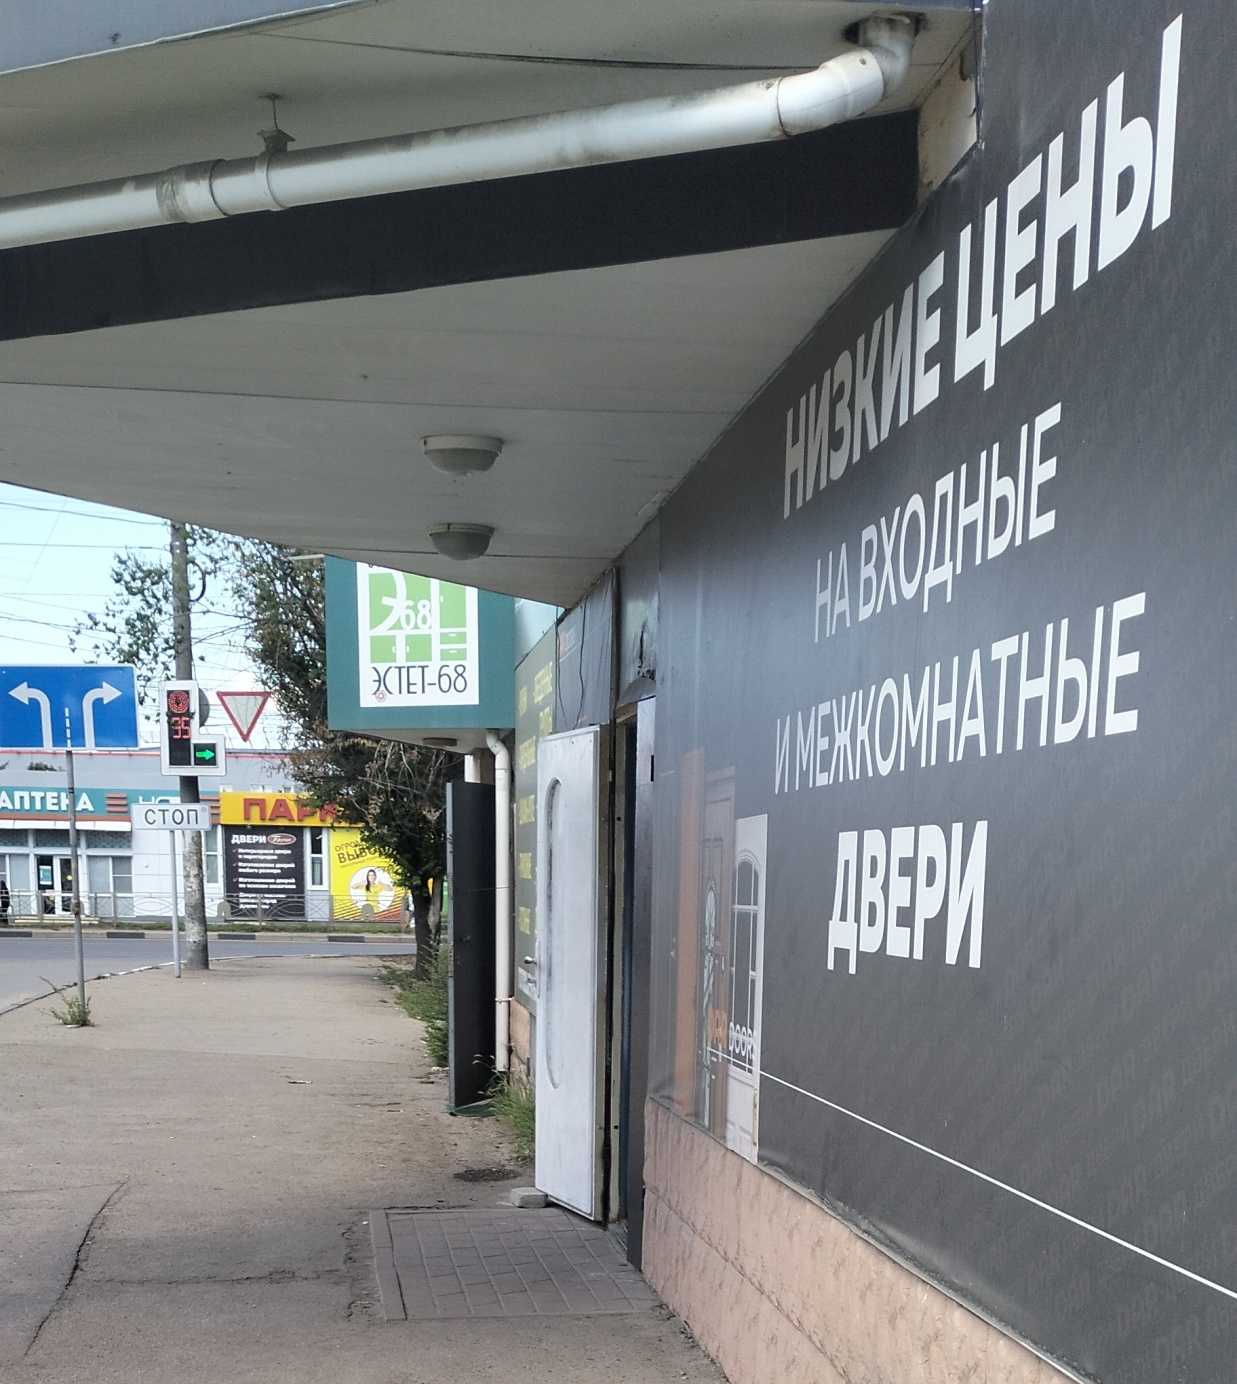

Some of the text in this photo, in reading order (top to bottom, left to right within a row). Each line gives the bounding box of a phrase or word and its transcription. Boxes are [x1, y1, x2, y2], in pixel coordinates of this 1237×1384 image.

[783, 14, 1183, 520] НИЗКИЕ ЦЕНЫ
[814, 402, 1062, 643] НА ВХОДНЫЕ
[400, 599, 432, 630] 68
[372, 664, 468, 695] ЭСТЕТ-68
[775, 591, 1147, 794] И МЕЖКОМНАТНЫЕ
[144, 808, 198, 825] СТОП
[231, 835, 267, 844] ДВЕРИ
[827, 820, 988, 974] ДВЕРИ
